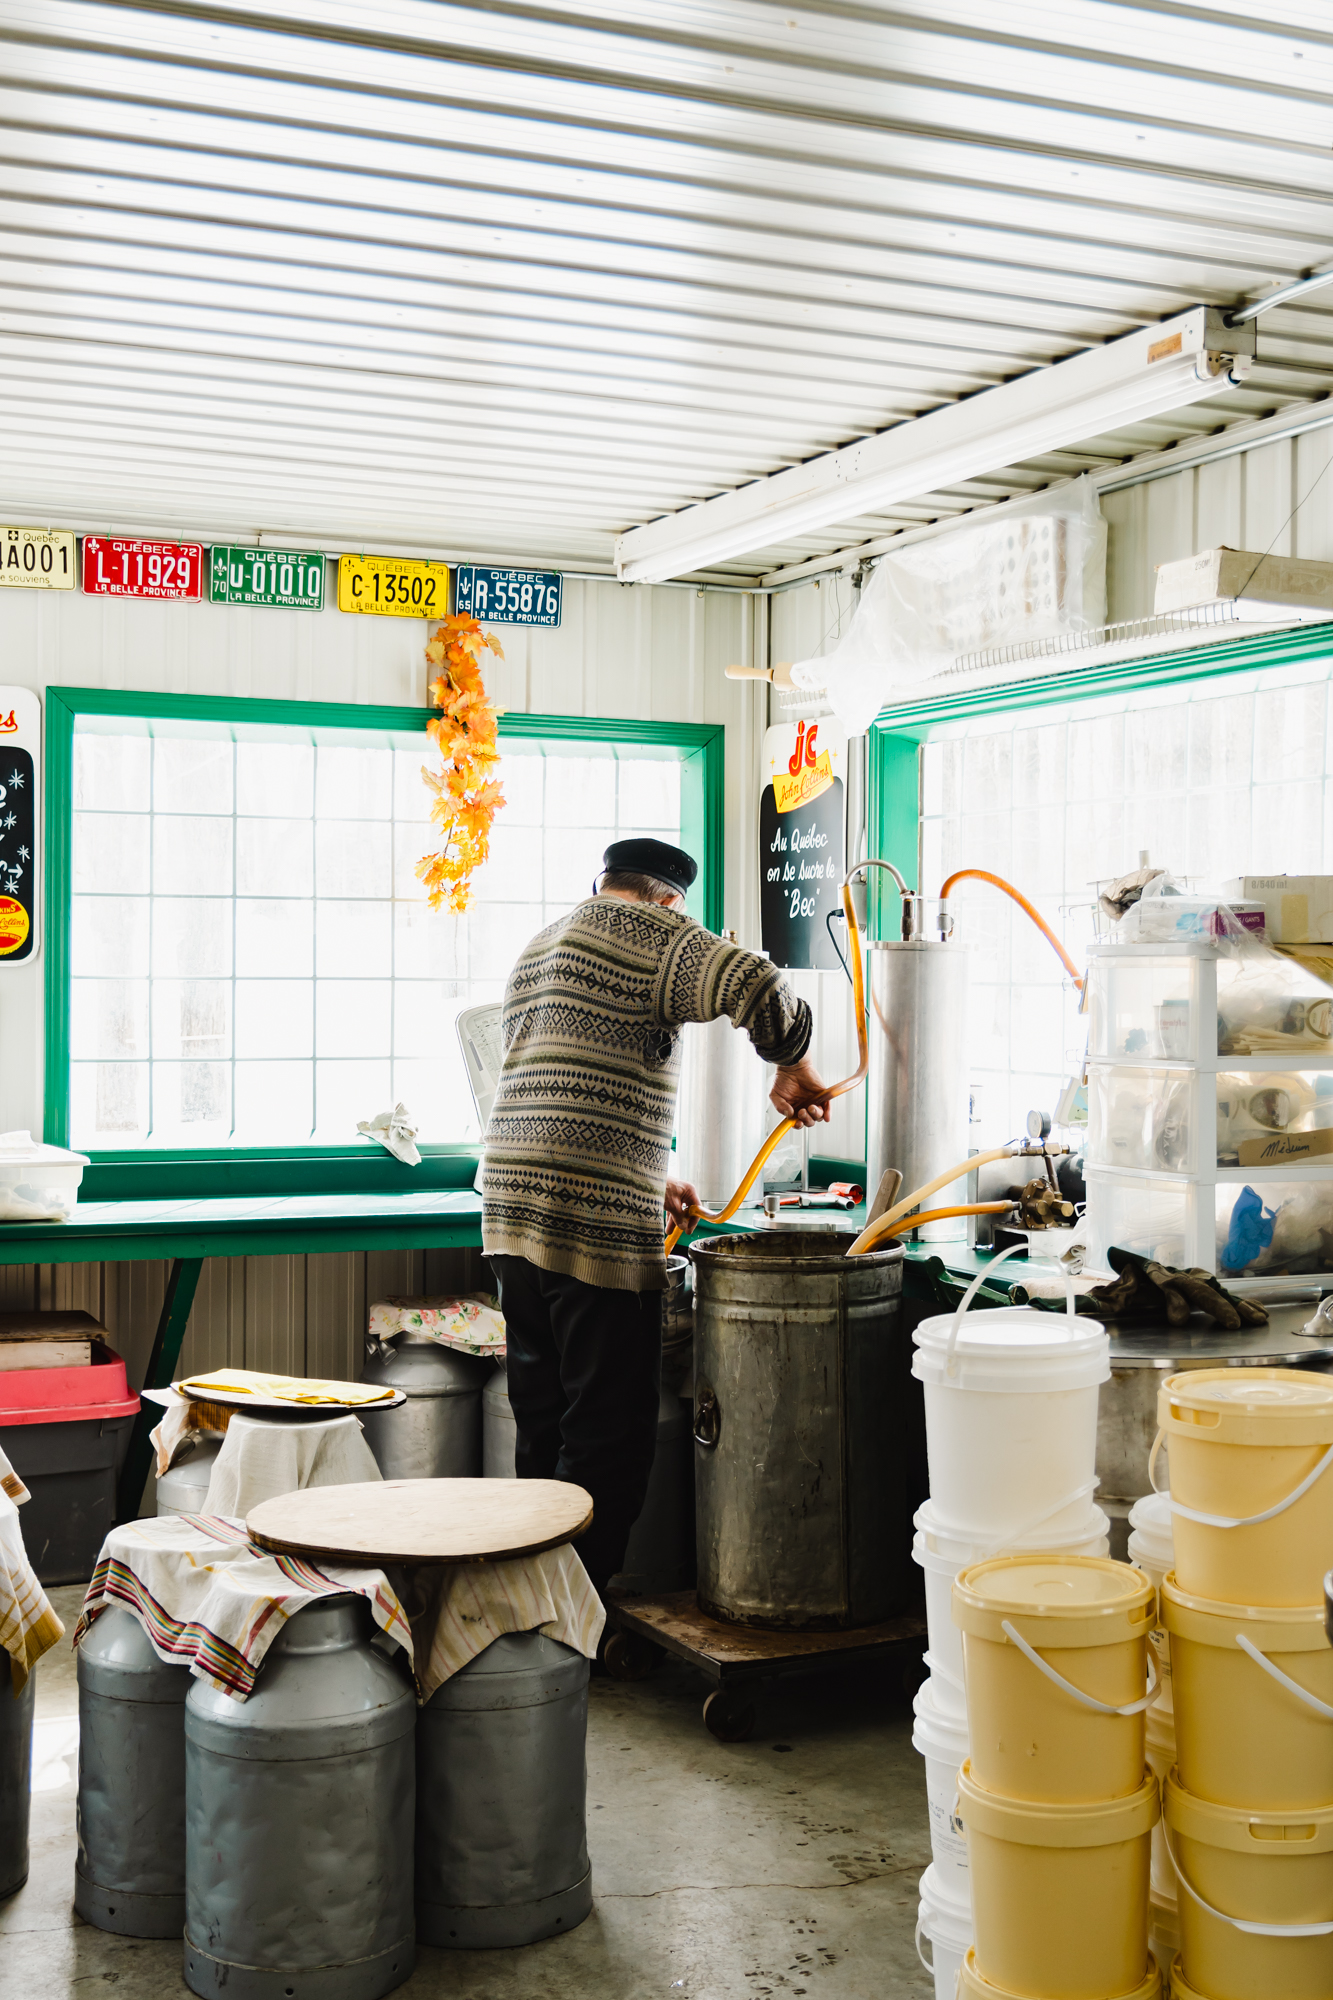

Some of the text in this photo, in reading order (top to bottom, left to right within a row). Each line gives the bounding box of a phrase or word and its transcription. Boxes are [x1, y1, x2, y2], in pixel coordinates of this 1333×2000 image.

[113, 541, 197, 557] QUÉBEC 72
[0, 541, 68, 574] A001
[245, 552, 307, 565] QUÉBEC
[98, 551, 190, 588] L-11929
[367, 563, 444, 576] QUÉBEC 74
[8, 574, 51, 584] souviens
[230, 562, 320, 597] U-01010
[491, 571, 543, 583] QUÉBEC
[95, 583, 187, 597] LA BELLE PROVINCE
[214, 581, 226, 593] 70
[352, 573, 436, 606] C-13502
[230, 593, 319, 607] LA BELLE PROVINCE
[475, 580, 558, 614] R-55876
[351, 602, 435, 616] LA BELLE PROVINCE
[459, 601, 471, 610] 65
[475, 611, 555, 624] LA BELLE PROVINCE
[779, 764, 829, 808] John Collins
[770, 822, 828, 853] Au Québec
[767, 856, 835, 882] on se sucre le
